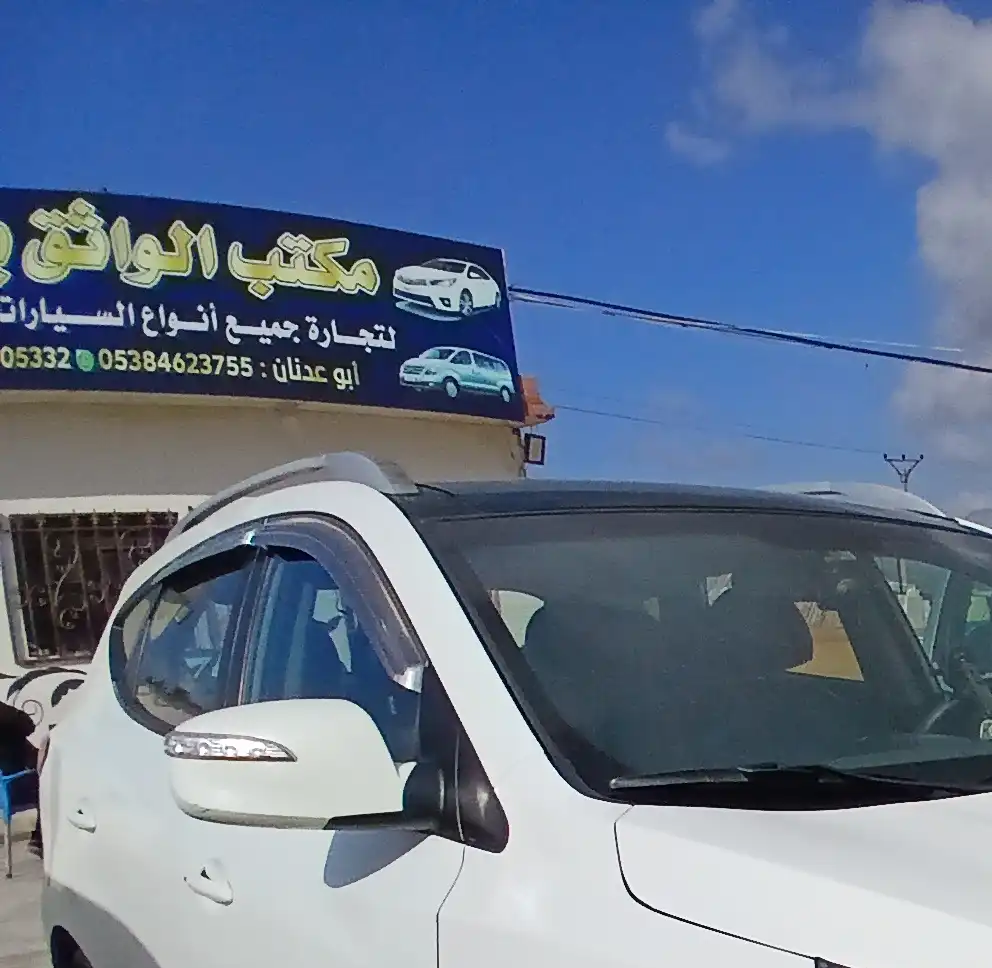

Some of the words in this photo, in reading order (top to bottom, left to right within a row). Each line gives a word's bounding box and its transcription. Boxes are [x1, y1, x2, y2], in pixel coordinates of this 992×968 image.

[21, 197, 218, 289] الواثق
[228, 231, 381, 300] مكتب
[141, 302, 219, 338] أنواع
[225, 314, 301, 345] جميع
[305, 315, 397, 353] لتجارة
[99, 348, 254, 378] 05384623755
[272, 357, 328, 383] عدنان
